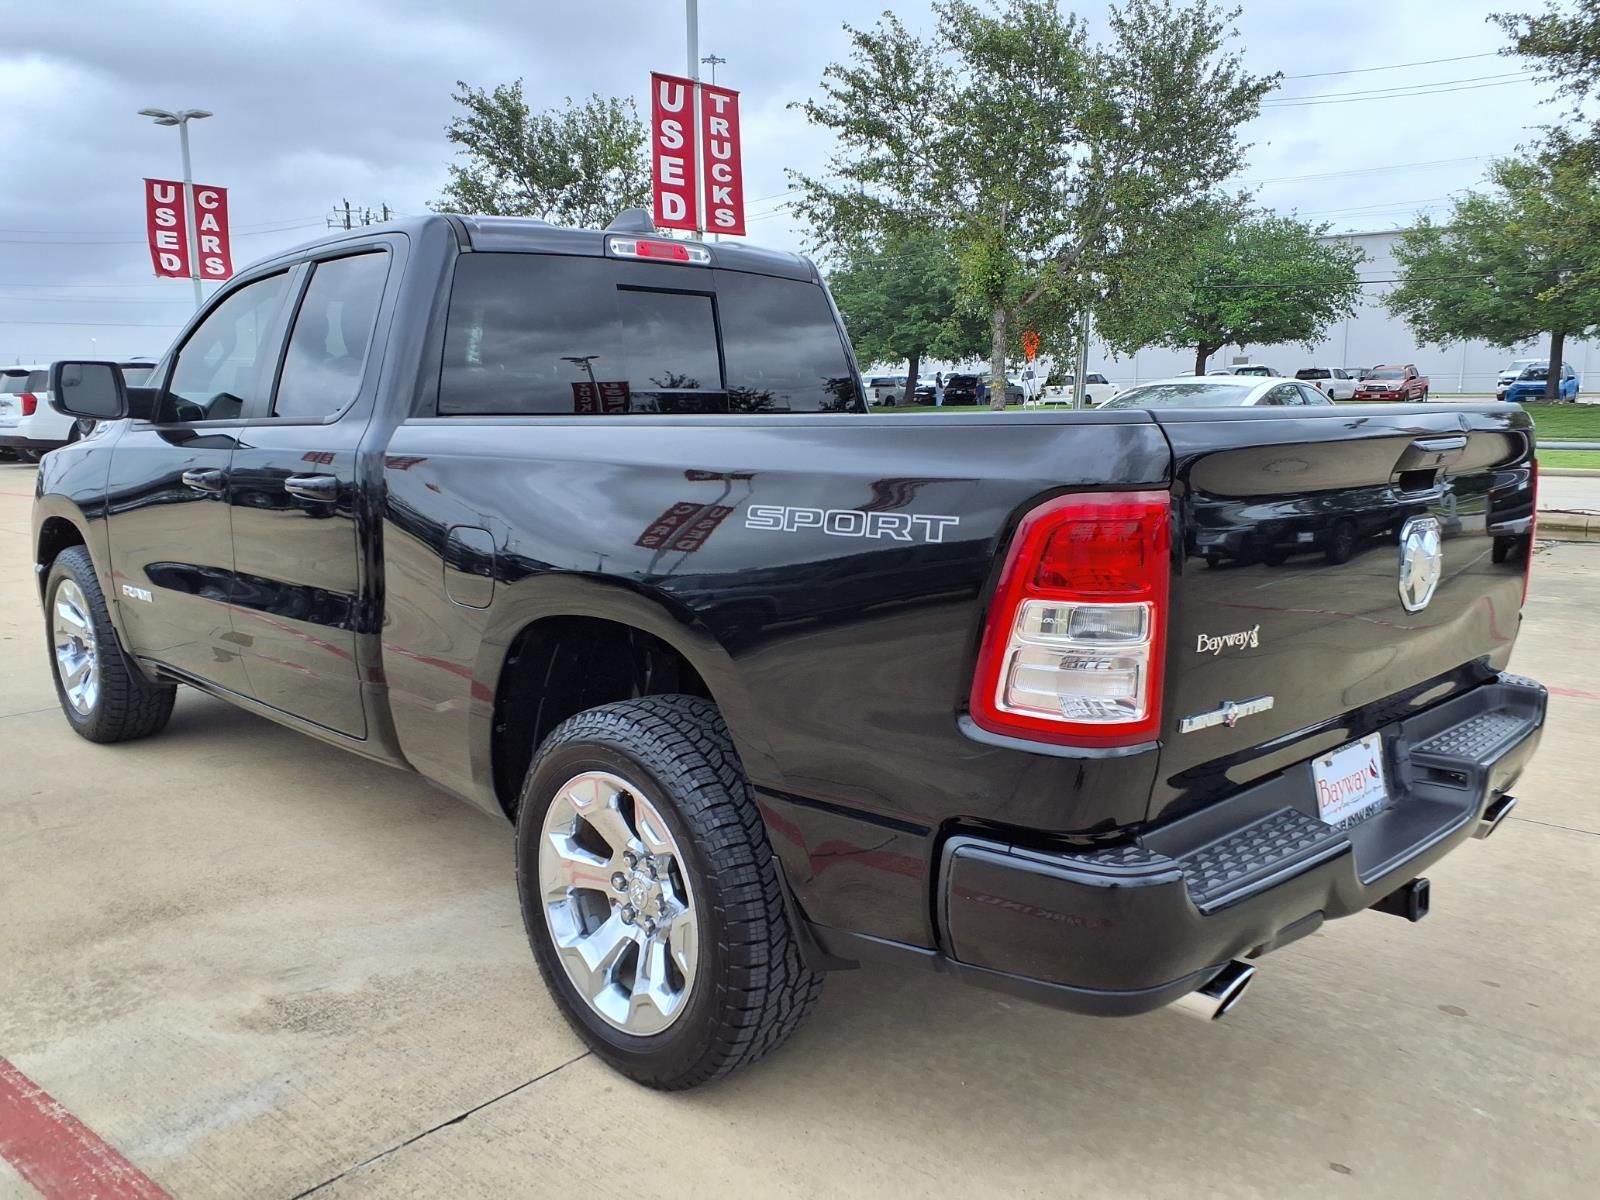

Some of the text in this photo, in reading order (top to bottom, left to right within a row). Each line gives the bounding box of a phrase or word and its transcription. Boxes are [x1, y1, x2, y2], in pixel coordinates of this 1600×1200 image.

[659, 81, 686, 221] USED
[709, 93, 736, 227] TRUCKS
[153, 184, 181, 271] USED
[198, 191, 225, 275] CARS
[745, 504, 960, 543] SPORT
[1196, 630, 1253, 655] Bayway
[1318, 767, 1369, 812] Bayway
